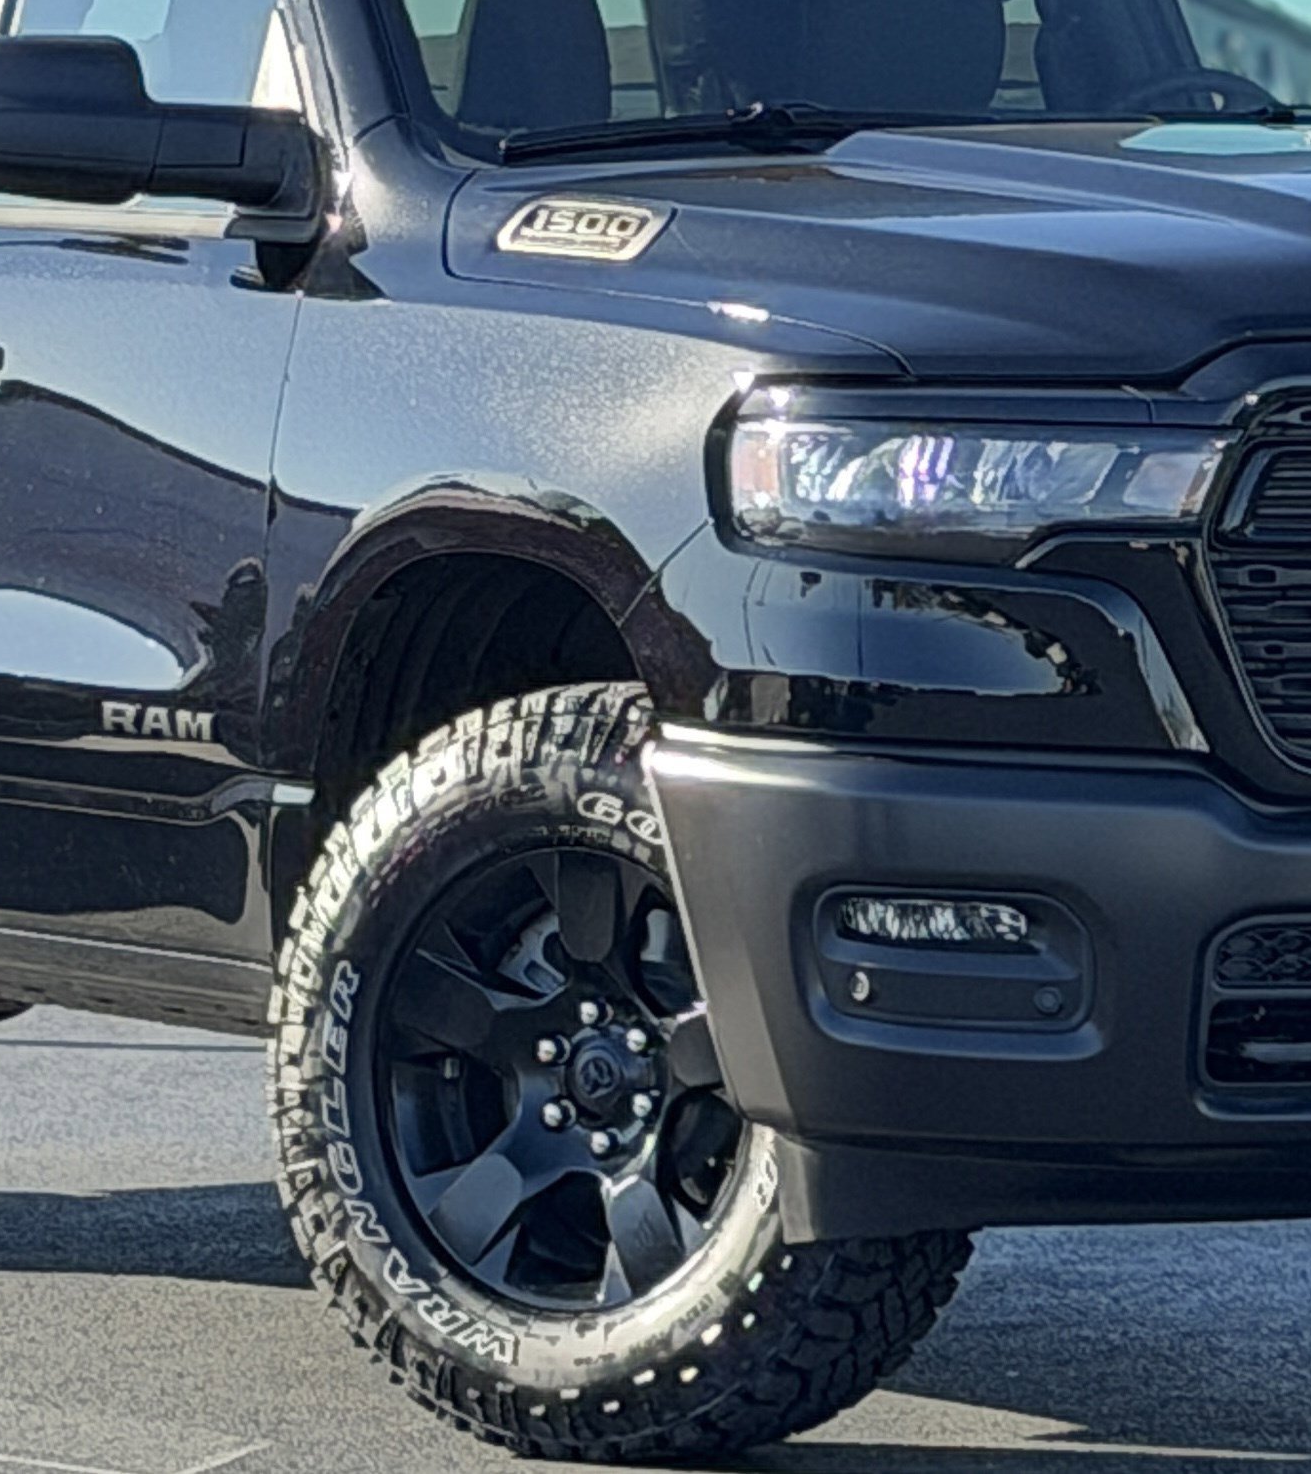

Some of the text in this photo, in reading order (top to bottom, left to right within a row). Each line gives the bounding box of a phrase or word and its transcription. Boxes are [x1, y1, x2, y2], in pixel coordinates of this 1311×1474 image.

[532, 208, 642, 239] 1500
[100, 700, 216, 742] RAM
[322, 959, 519, 1365] WRANGLER
